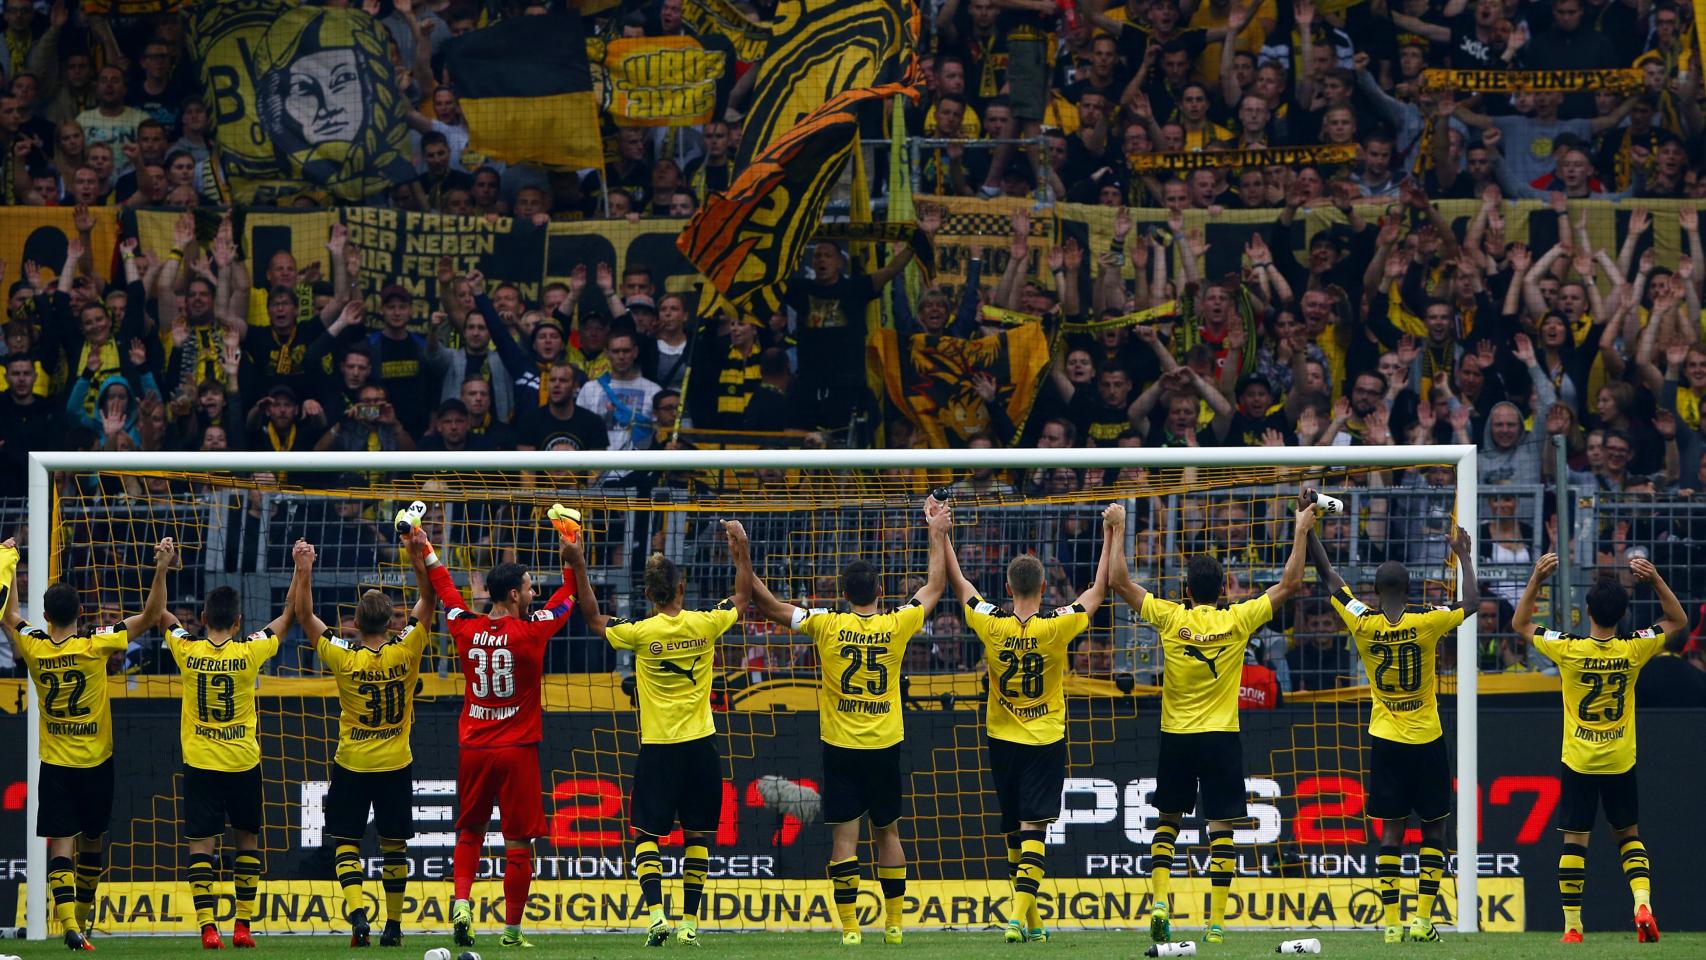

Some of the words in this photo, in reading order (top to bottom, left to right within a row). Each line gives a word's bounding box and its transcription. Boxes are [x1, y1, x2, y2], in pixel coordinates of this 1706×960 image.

[1456, 71, 1506, 88] THE
[1533, 71, 1613, 88] UNITY
[1166, 152, 1216, 168] THE
[346, 207, 398, 229] DER
[406, 211, 513, 233] FREUND
[347, 223, 397, 250] DER
[406, 232, 495, 254] NEBEN
[403, 255, 480, 277] FELT
[666, 638, 707, 651] EVONIK
[838, 629, 891, 644] SOKRATIS
[1004, 637, 1038, 650] GINTER
[1373, 627, 1418, 642] RAMOS
[186, 656, 247, 671] GUERREIRO
[352, 663, 408, 681] PASSLACK
[468, 648, 516, 698] 38
[840, 645, 888, 695] 25
[998, 650, 1044, 698] 28
[1370, 642, 1422, 692] 20
[1583, 657, 1630, 670] KAGAWA
[40, 669, 91, 718] 22
[197, 672, 235, 723] 13
[357, 680, 406, 728] 30
[837, 699, 891, 714] DORTMUND
[1578, 672, 1628, 721] 23
[1045, 778, 1281, 844] PES
[212, 893, 328, 923] DUNA
[700, 892, 832, 922] IDUNA
[901, 896, 1010, 923] PARK
[1399, 894, 1515, 922] PAK
